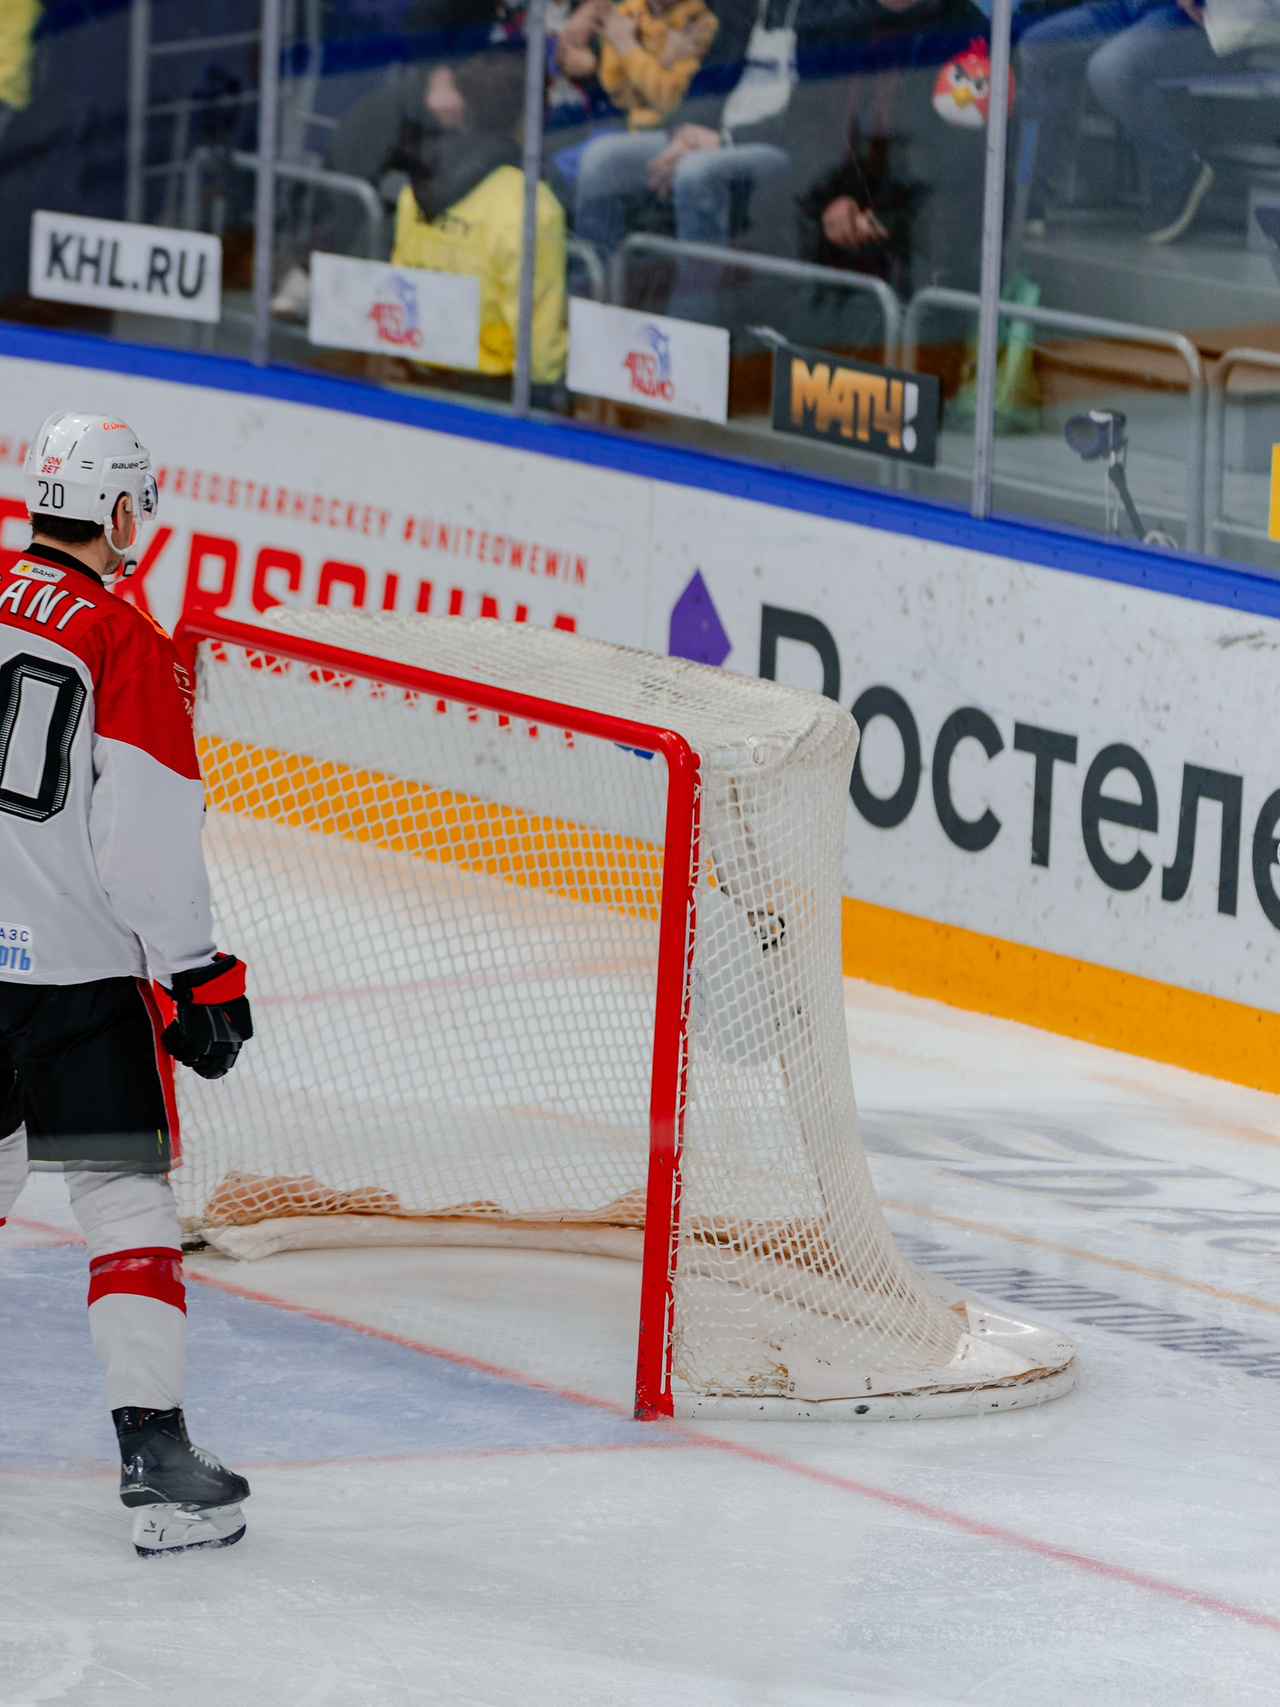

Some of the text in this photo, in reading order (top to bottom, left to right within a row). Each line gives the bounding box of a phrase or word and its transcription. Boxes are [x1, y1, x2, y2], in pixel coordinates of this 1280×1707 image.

[43, 230, 208, 300] KHL.RU
[790, 358, 919, 455] МАТЧ!
[41, 464, 60, 475] BET
[44, 456, 63, 466] FON
[111, 462, 139, 470] BAUER
[38, 480, 65, 509] 20
[402, 514, 589, 586] #UNITEDWEWIN
[31, 567, 58, 579] БАНК
